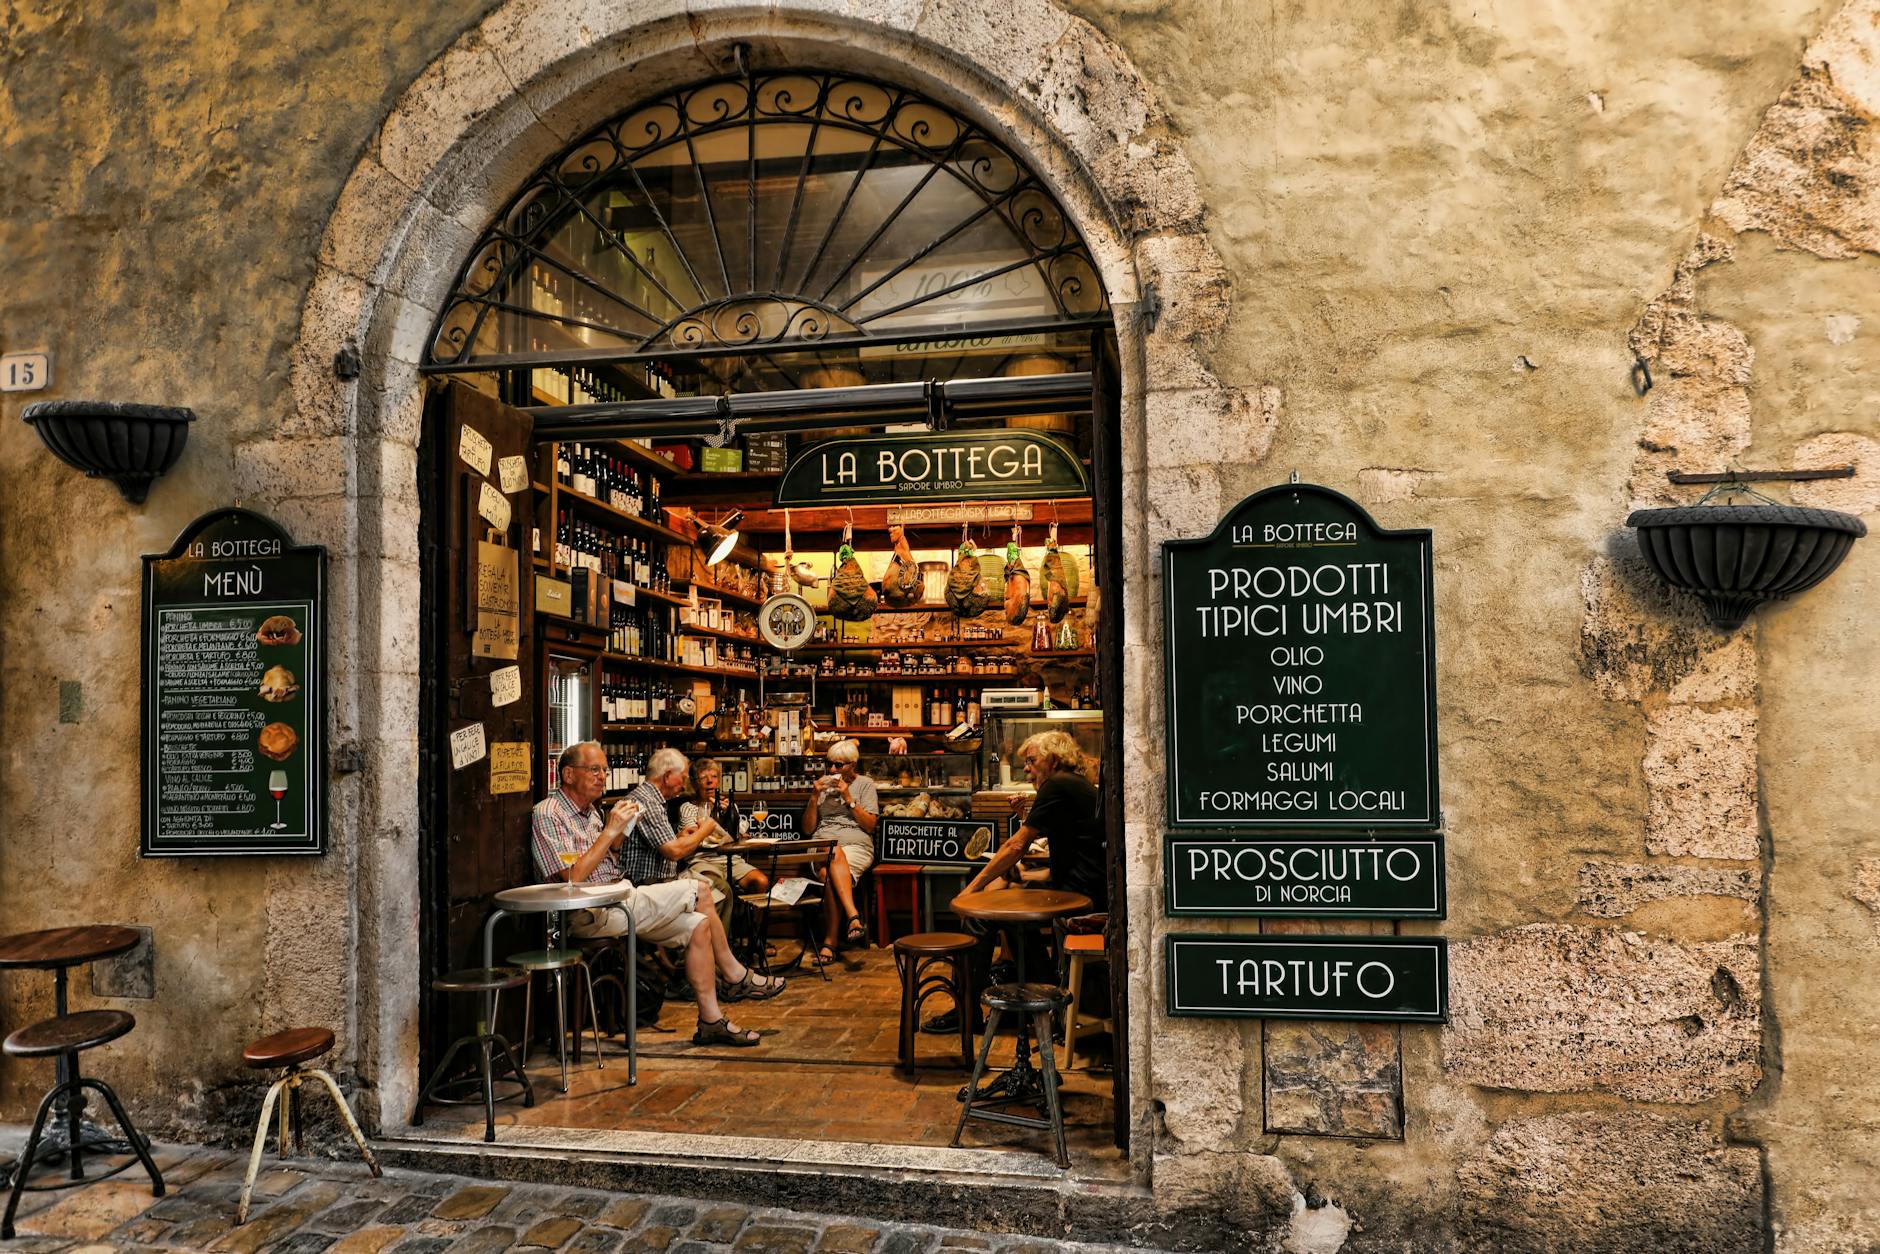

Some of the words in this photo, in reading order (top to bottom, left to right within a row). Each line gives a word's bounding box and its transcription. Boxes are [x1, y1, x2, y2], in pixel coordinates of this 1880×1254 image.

[11, 363, 34, 385] 15
[822, 452, 856, 484] LA
[876, 444, 1042, 482] BOTTEGA
[898, 482, 930, 492] SAPORE
[934, 481, 962, 490] UMBRO
[1232, 524, 1252, 543] LA
[1264, 522, 1356, 542] BOTTEGA
[188, 542, 204, 558] LA
[212, 539, 280, 556] BOTTEGA
[204, 564, 262, 596] MENÙ
[1208, 563, 1388, 599] PRODOTTI
[1196, 604, 1287, 637] TIPICI
[1302, 601, 1401, 634] UMBRI
[1270, 646, 1324, 666] OLIO
[1272, 675, 1322, 694] VINO
[1236, 704, 1361, 724] PORCHETTA
[1262, 734, 1336, 752] LEGUMI
[1267, 762, 1333, 781] SALUMI
[1200, 791, 1318, 810] FORMAGGI
[1329, 790, 1404, 810] LOCALI
[888, 825, 943, 836] BRUSCHETTE
[948, 827, 958, 837] AL
[888, 838, 958, 857] TARTUFO
[1188, 848, 1420, 881] PROSCIUTTO
[1255, 886, 1270, 902] DI
[1281, 885, 1350, 902] NORCIA
[1216, 959, 1394, 998] TARTUFO
